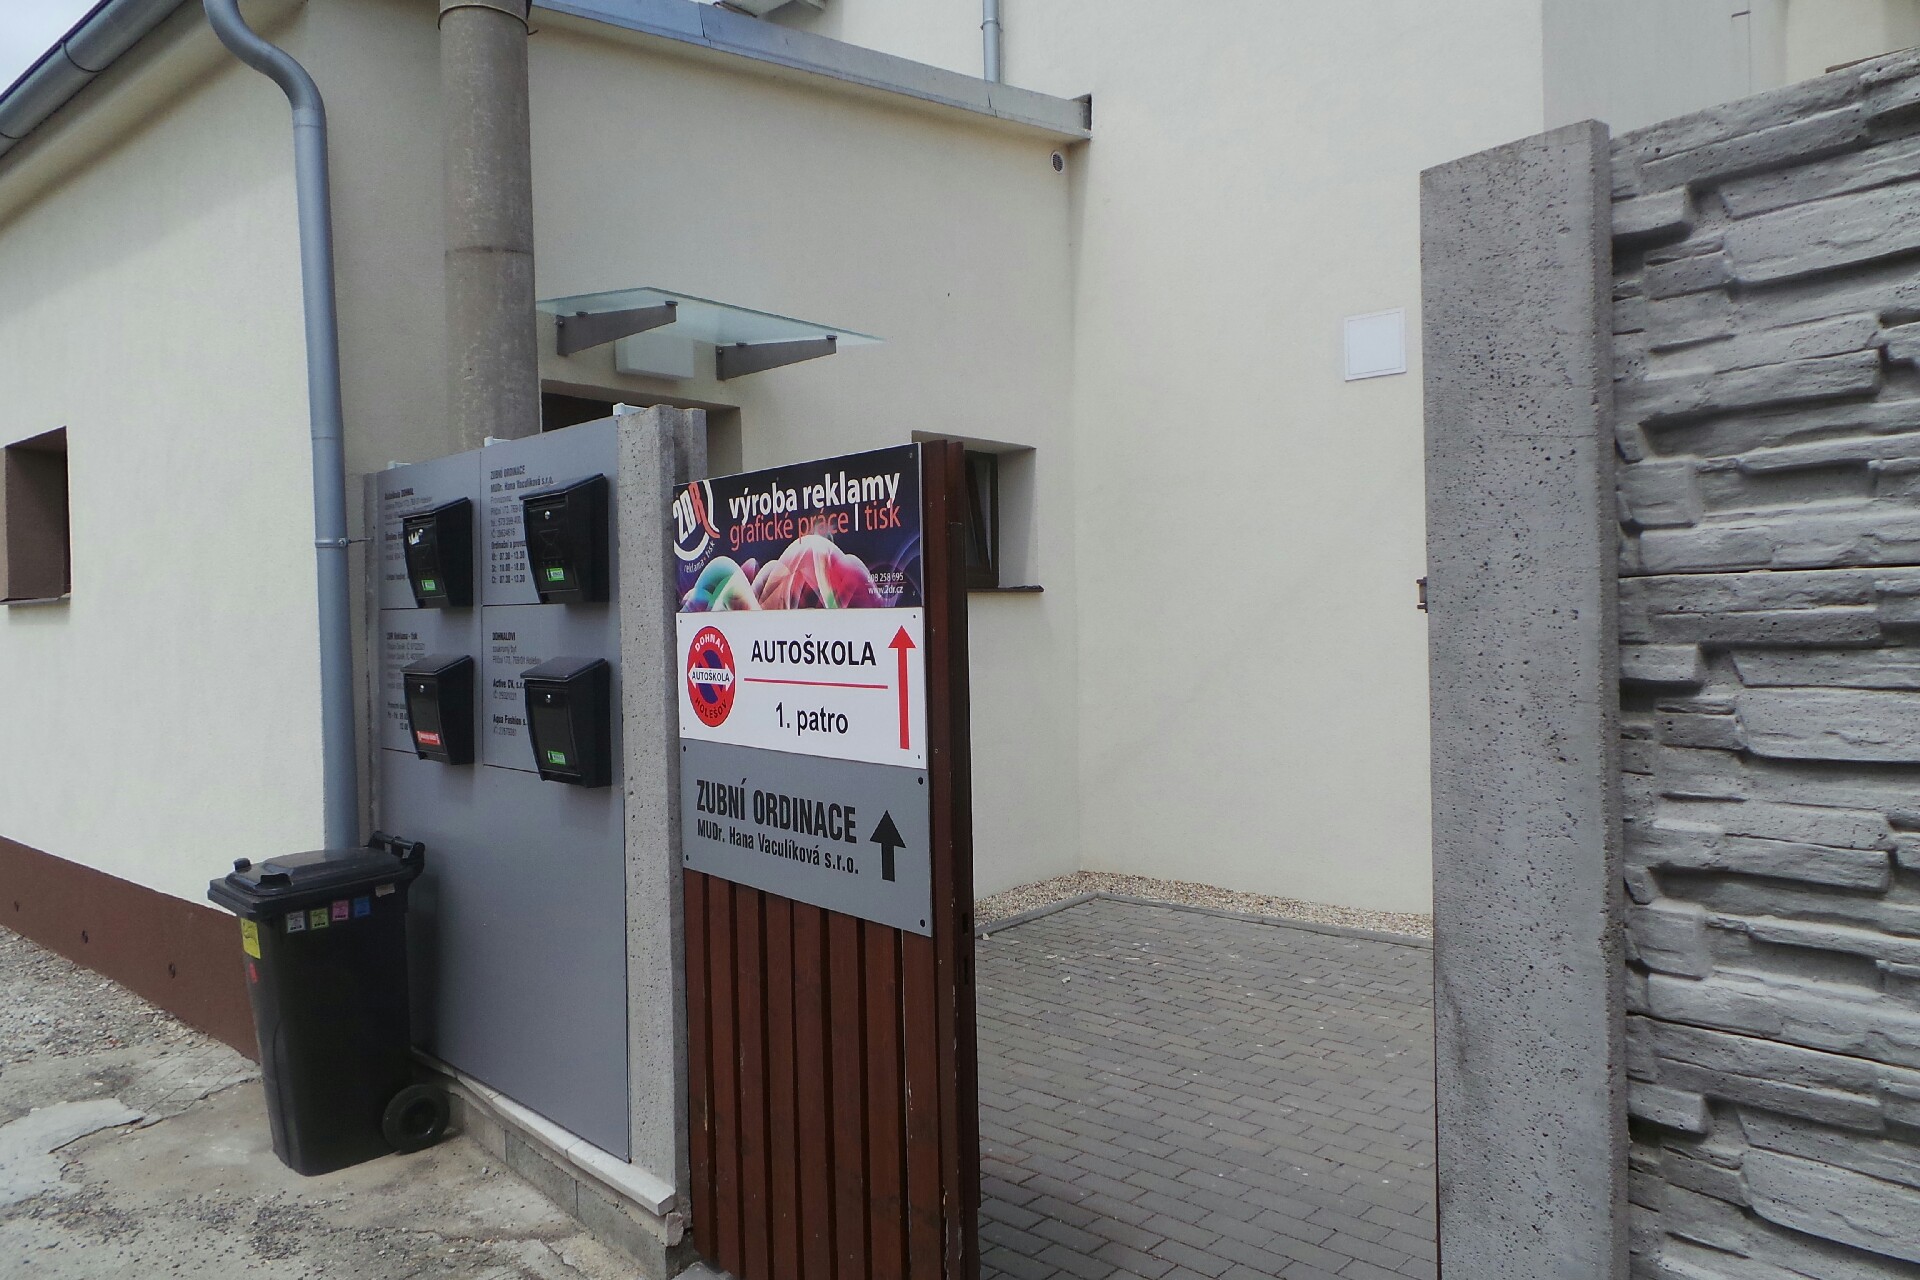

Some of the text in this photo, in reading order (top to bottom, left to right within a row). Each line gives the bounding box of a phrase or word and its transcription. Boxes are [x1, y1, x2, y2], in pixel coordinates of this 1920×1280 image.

[542, 476, 554, 485] s.r.o.
[728, 471, 900, 526] výroba reklamy
[673, 481, 720, 544] 2DR
[729, 512, 793, 551] grafické
[798, 508, 848, 545] práce
[864, 497, 901, 531] tisk
[705, 541, 715, 558] tisk
[684, 559, 704, 573] reklama
[880, 572, 890, 582] 258
[892, 572, 904, 581] 695
[868, 585, 904, 594] www.2dr.cz
[694, 633, 725, 653] DOHNAL
[751, 634, 876, 666] AUTOŠKOLA
[692, 670, 730, 683] AUTOŠKOLA
[694, 698, 727, 719] HOLEŠOV
[776, 702, 848, 736] 1. patro
[696, 778, 857, 844] ZUBNÍ ORDINACE
[697, 818, 859, 874] MUDr. Hana Vaculíková s.r.o.
